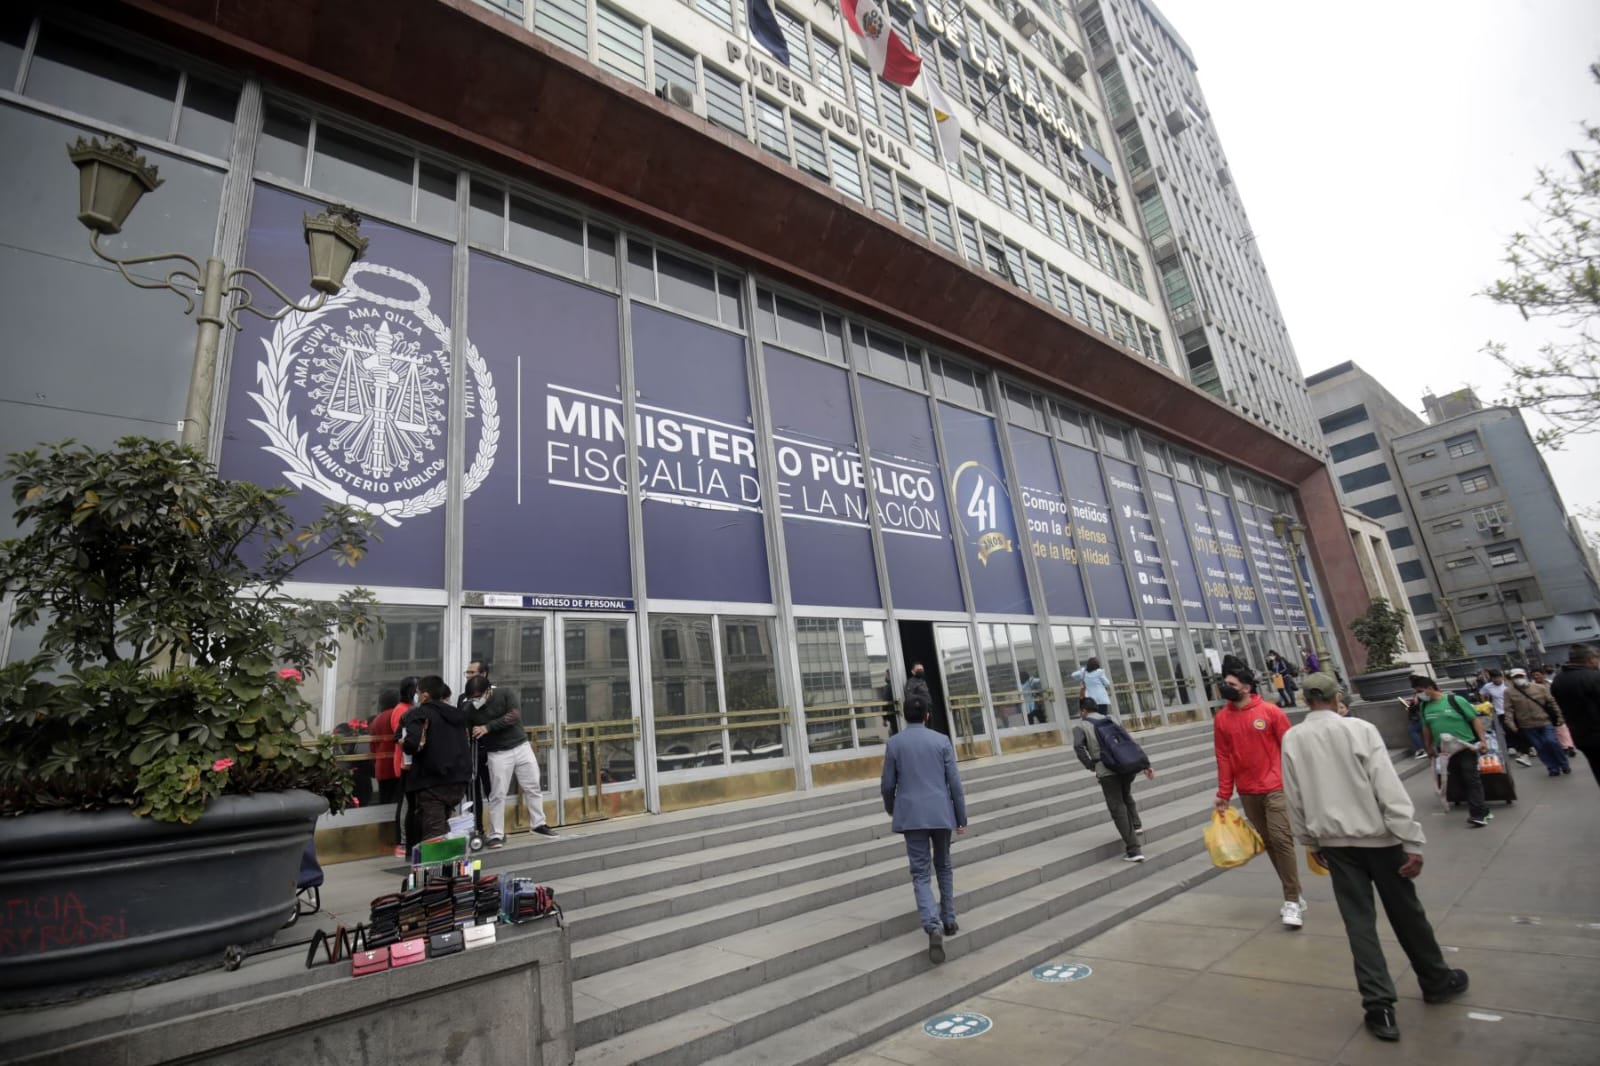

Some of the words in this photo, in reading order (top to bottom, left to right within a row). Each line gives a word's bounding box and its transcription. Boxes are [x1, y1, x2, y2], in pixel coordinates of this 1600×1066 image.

[967, 41, 1000, 80] LA
[726, 40, 807, 107] PODER
[819, 101, 911, 170] JUDICIAL
[302, 323, 334, 355] SUWA
[348, 307, 380, 320] AMA
[384, 311, 423, 336] QILLA
[294, 358, 311, 388] AMA
[546, 395, 802, 477] MINISTERO
[810, 451, 935, 502] PÚBLICO
[310, 444, 389, 493] MINISTERIO
[393, 460, 443, 493] PÚBLICO
[547, 441, 729, 498] FISCALÍA
[740, 474, 793, 510] DE
[802, 485, 838, 516] LA
[844, 493, 941, 532] NACIÓN
[967, 474, 996, 531] 41
[1027, 518, 1049, 534] con
[1051, 519, 1062, 536] la
[1032, 540, 1047, 558] de
[1049, 541, 1059, 560] la
[531, 597, 570, 607] INGRESO
[572, 598, 583, 608] DE
[585, 599, 626, 609] PERSONAL
